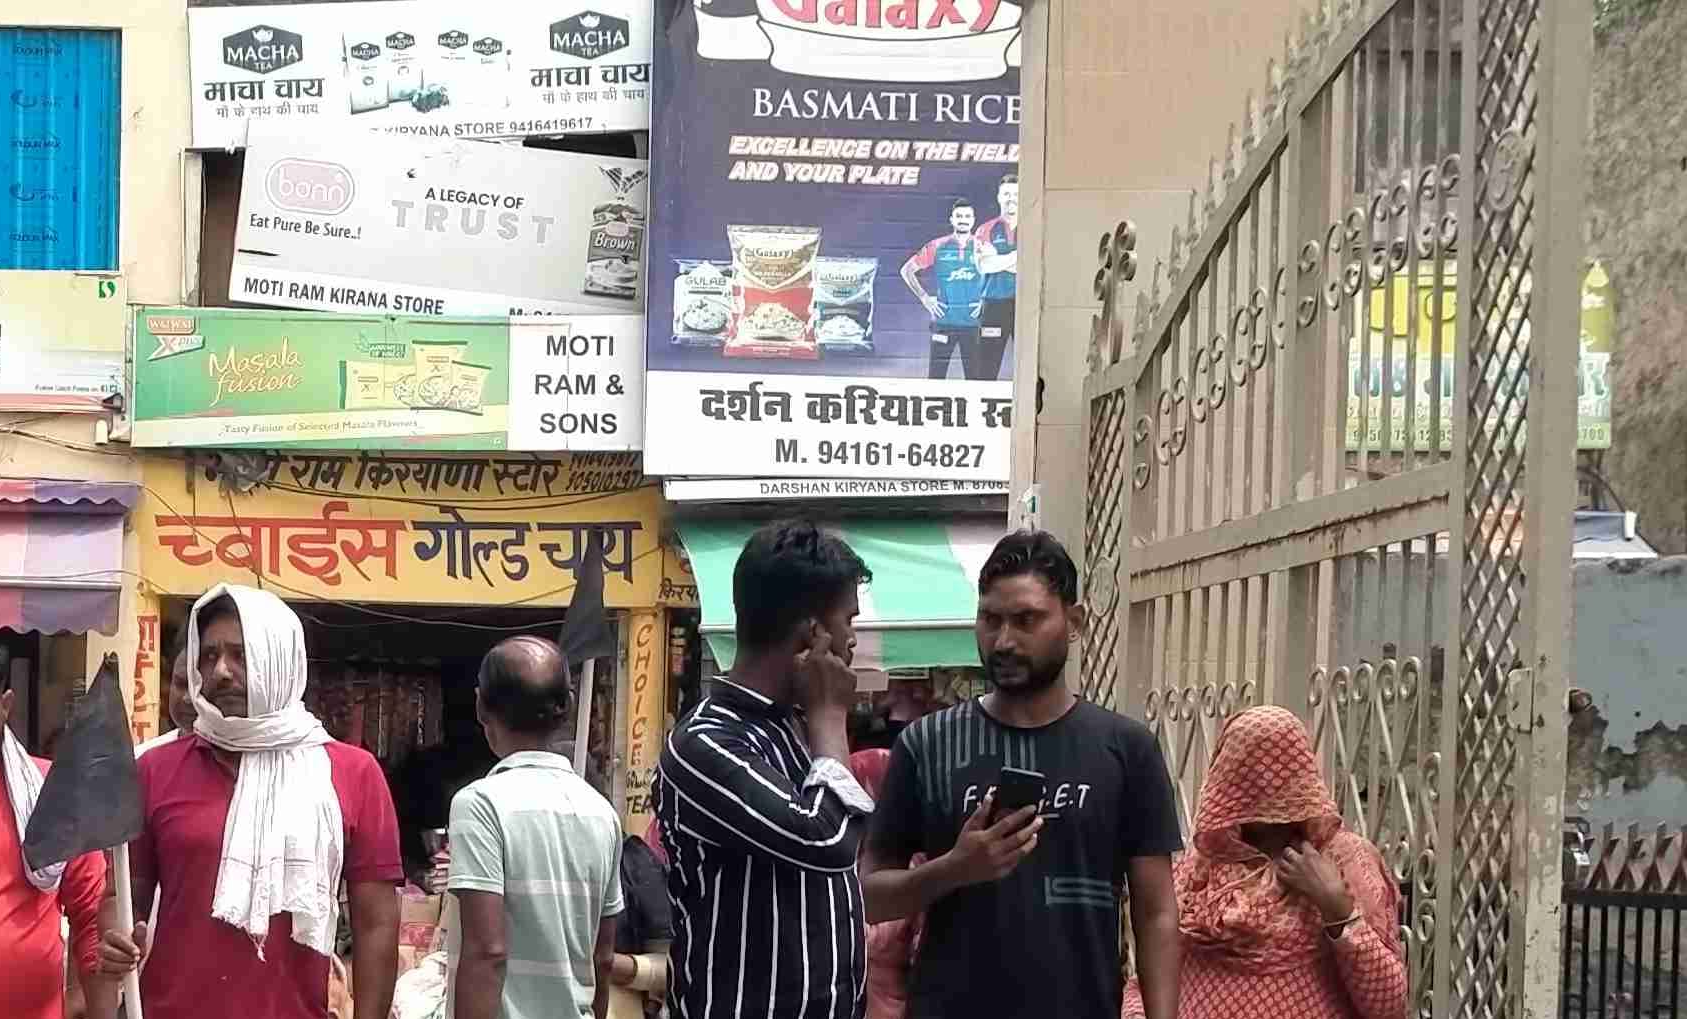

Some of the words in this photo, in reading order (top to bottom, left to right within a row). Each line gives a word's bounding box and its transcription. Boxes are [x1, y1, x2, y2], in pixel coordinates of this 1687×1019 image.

[553, 30, 626, 48] MACHA
[227, 44, 300, 62] MACHA
[254, 62, 273, 72] TEA
[529, 66, 592, 88] माचा
[599, 63, 650, 84] चाय
[204, 80, 266, 102] माचा
[274, 78, 325, 99] चाय
[753, 88, 919, 122] BASMATI
[934, 94, 1021, 125] RICE
[454, 121, 504, 136] STORE
[509, 117, 593, 132] 9416419617
[729, 136, 873, 159] EXCELLENCE
[875, 140, 910, 160] ON
[913, 141, 957, 162] THE
[729, 161, 779, 183] AND
[783, 162, 845, 184] YOUR
[848, 165, 921, 186] PLATE
[425, 187, 437, 201] A
[440, 189, 501, 207] LEGACY
[503, 196, 525, 209] OF
[249, 213, 270, 229] Eat
[273, 216, 301, 233] Pure
[304, 221, 320, 235] Be
[392, 199, 555, 244] TRUST
[594, 232, 636, 251] Brown
[243, 277, 284, 297] MOTI
[289, 282, 325, 302] RAM
[329, 287, 388, 309] KIRANA
[393, 294, 445, 316] STORE
[209, 336, 304, 376] Masala
[545, 335, 615, 356] MOTI
[534, 374, 597, 395] RAM
[606, 373, 625, 395] &
[699, 381, 793, 422] दर्शन
[805, 385, 968, 427] करियाना
[540, 412, 618, 434] SONS
[775, 438, 807, 464] M.
[818, 441, 986, 468] 94161-64827
[760, 482, 830, 495] DARSHAN
[835, 481, 898, 494] KIRYANA
[901, 480, 949, 492] STORE
[412, 506, 533, 587] गोल्ड
[631, 623, 653, 767] CHOICE
